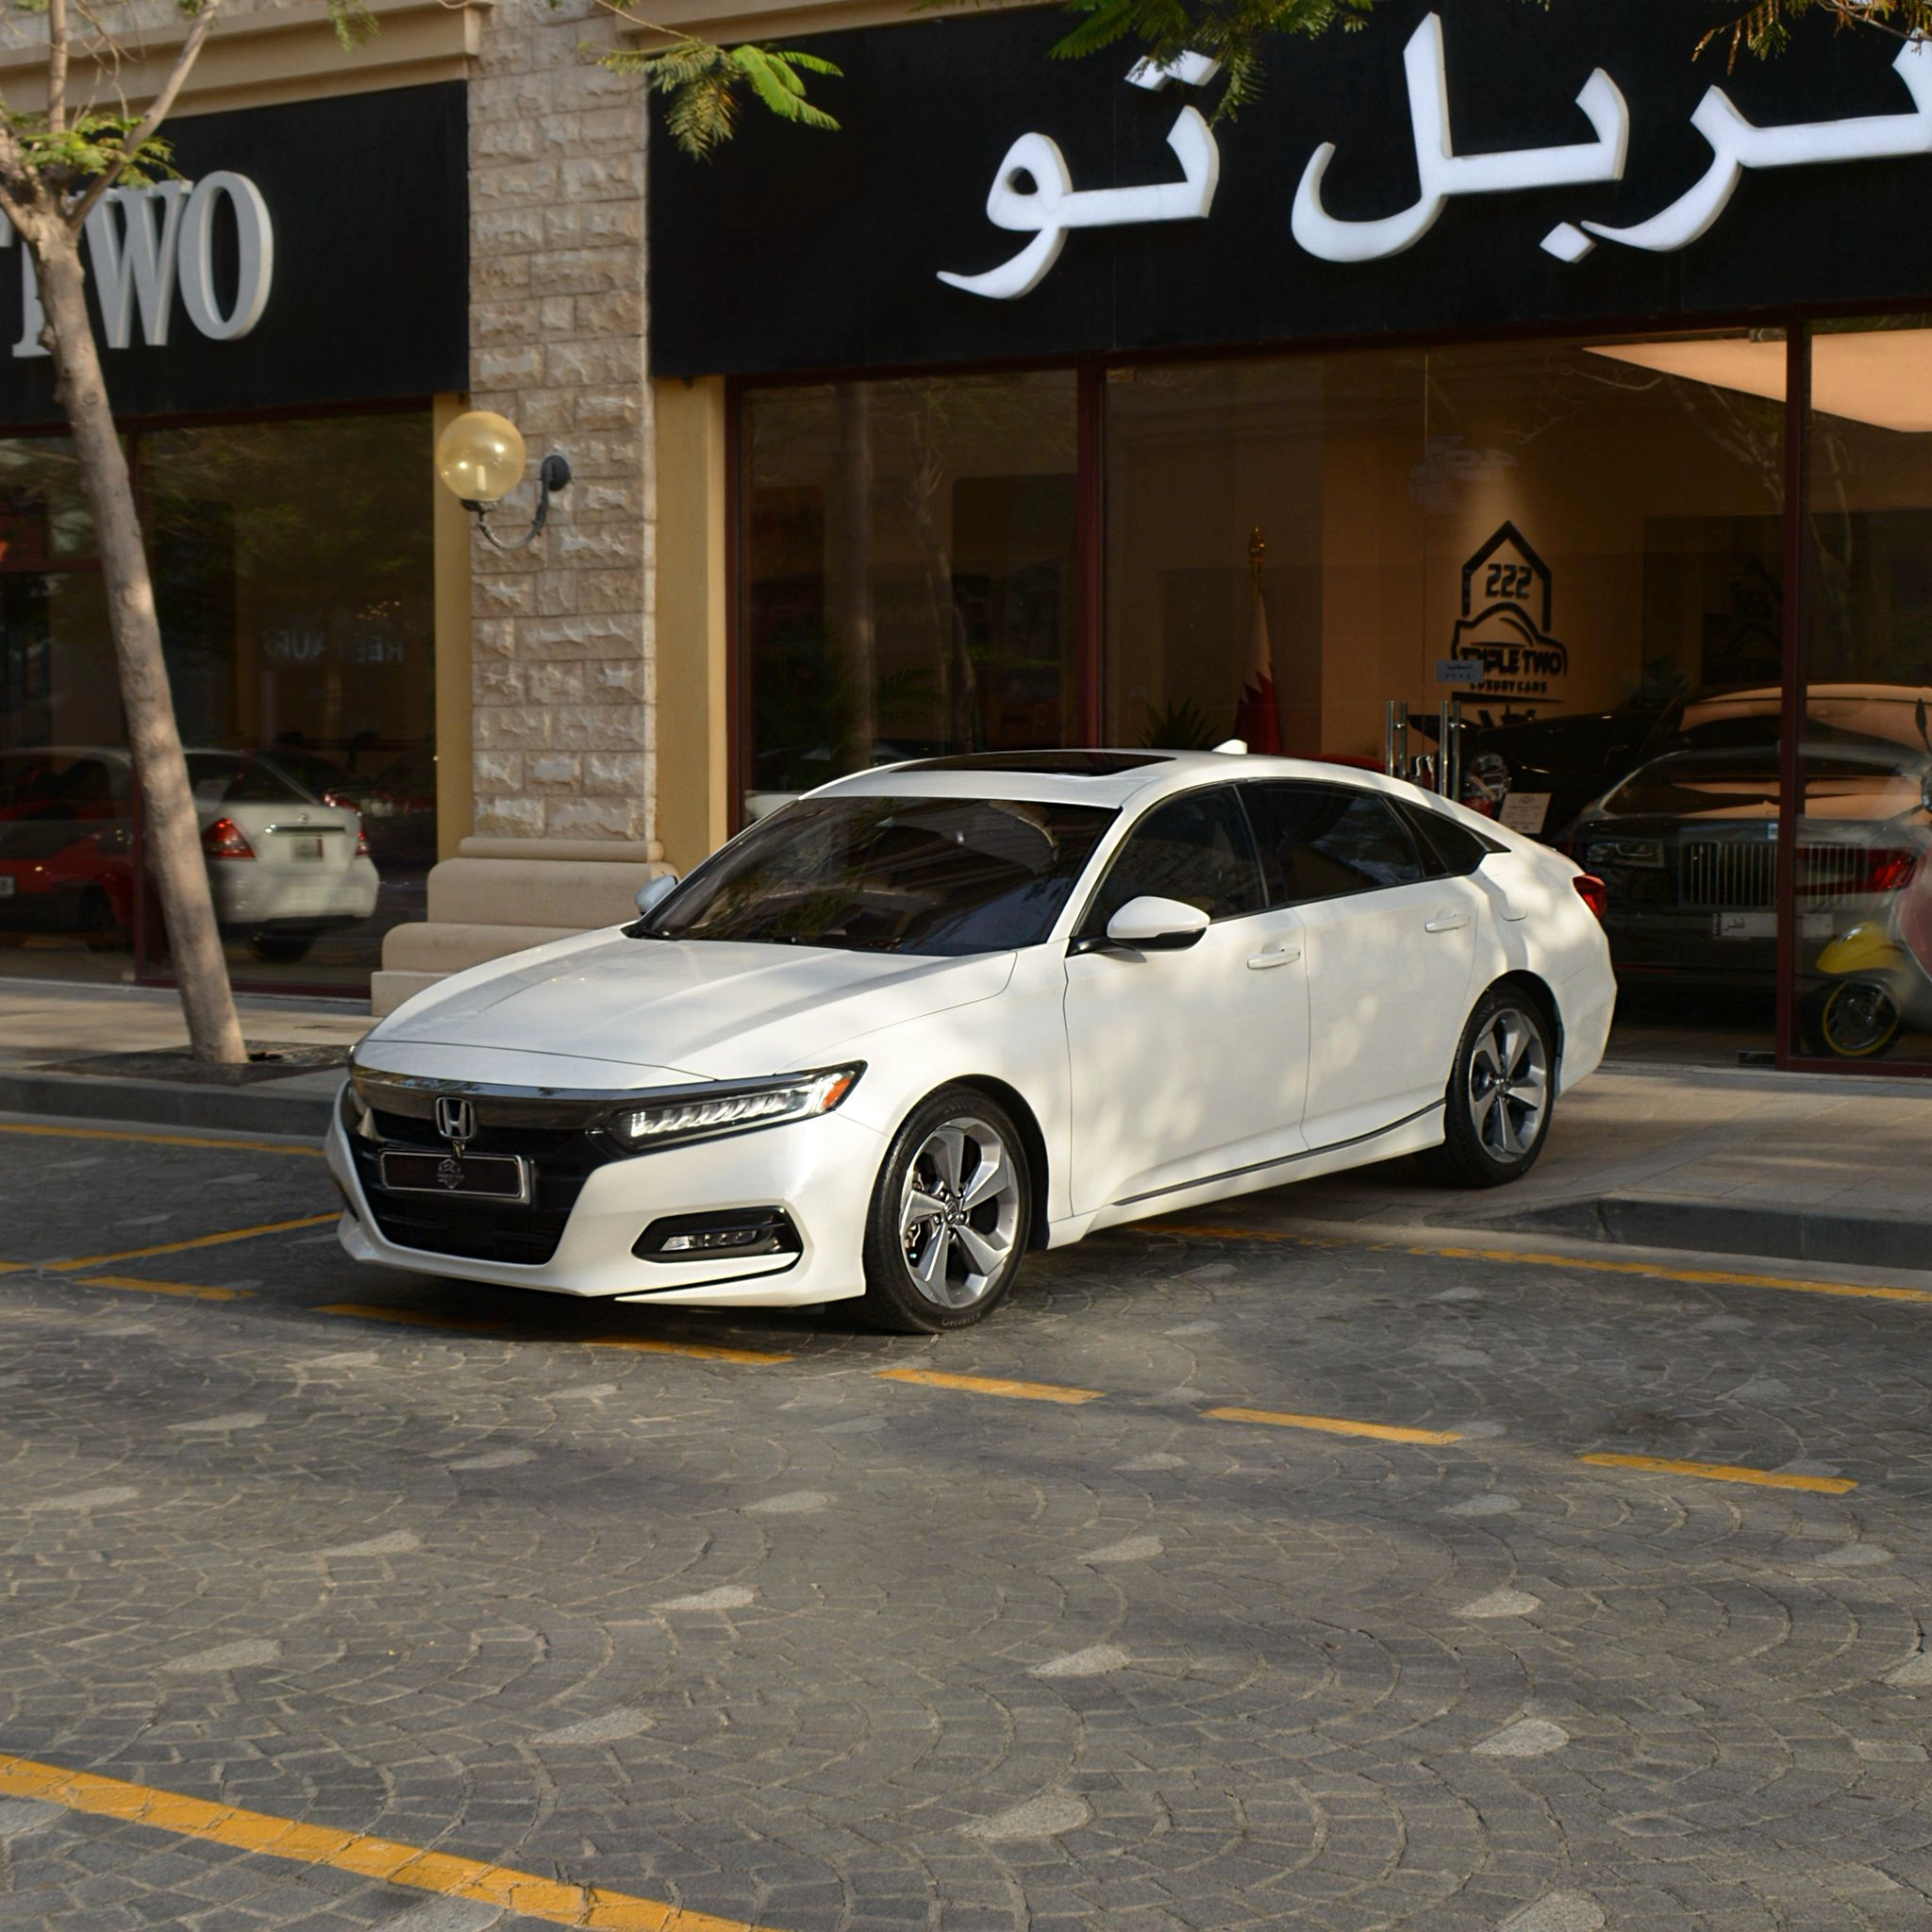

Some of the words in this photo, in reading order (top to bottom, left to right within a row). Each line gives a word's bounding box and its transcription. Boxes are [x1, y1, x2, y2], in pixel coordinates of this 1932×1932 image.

[936, 49, 1222, 300] تو
[1486, 563, 1532, 599] 222
[1522, 649, 1561, 676] TWO
[1517, 680, 1548, 693] CARS
